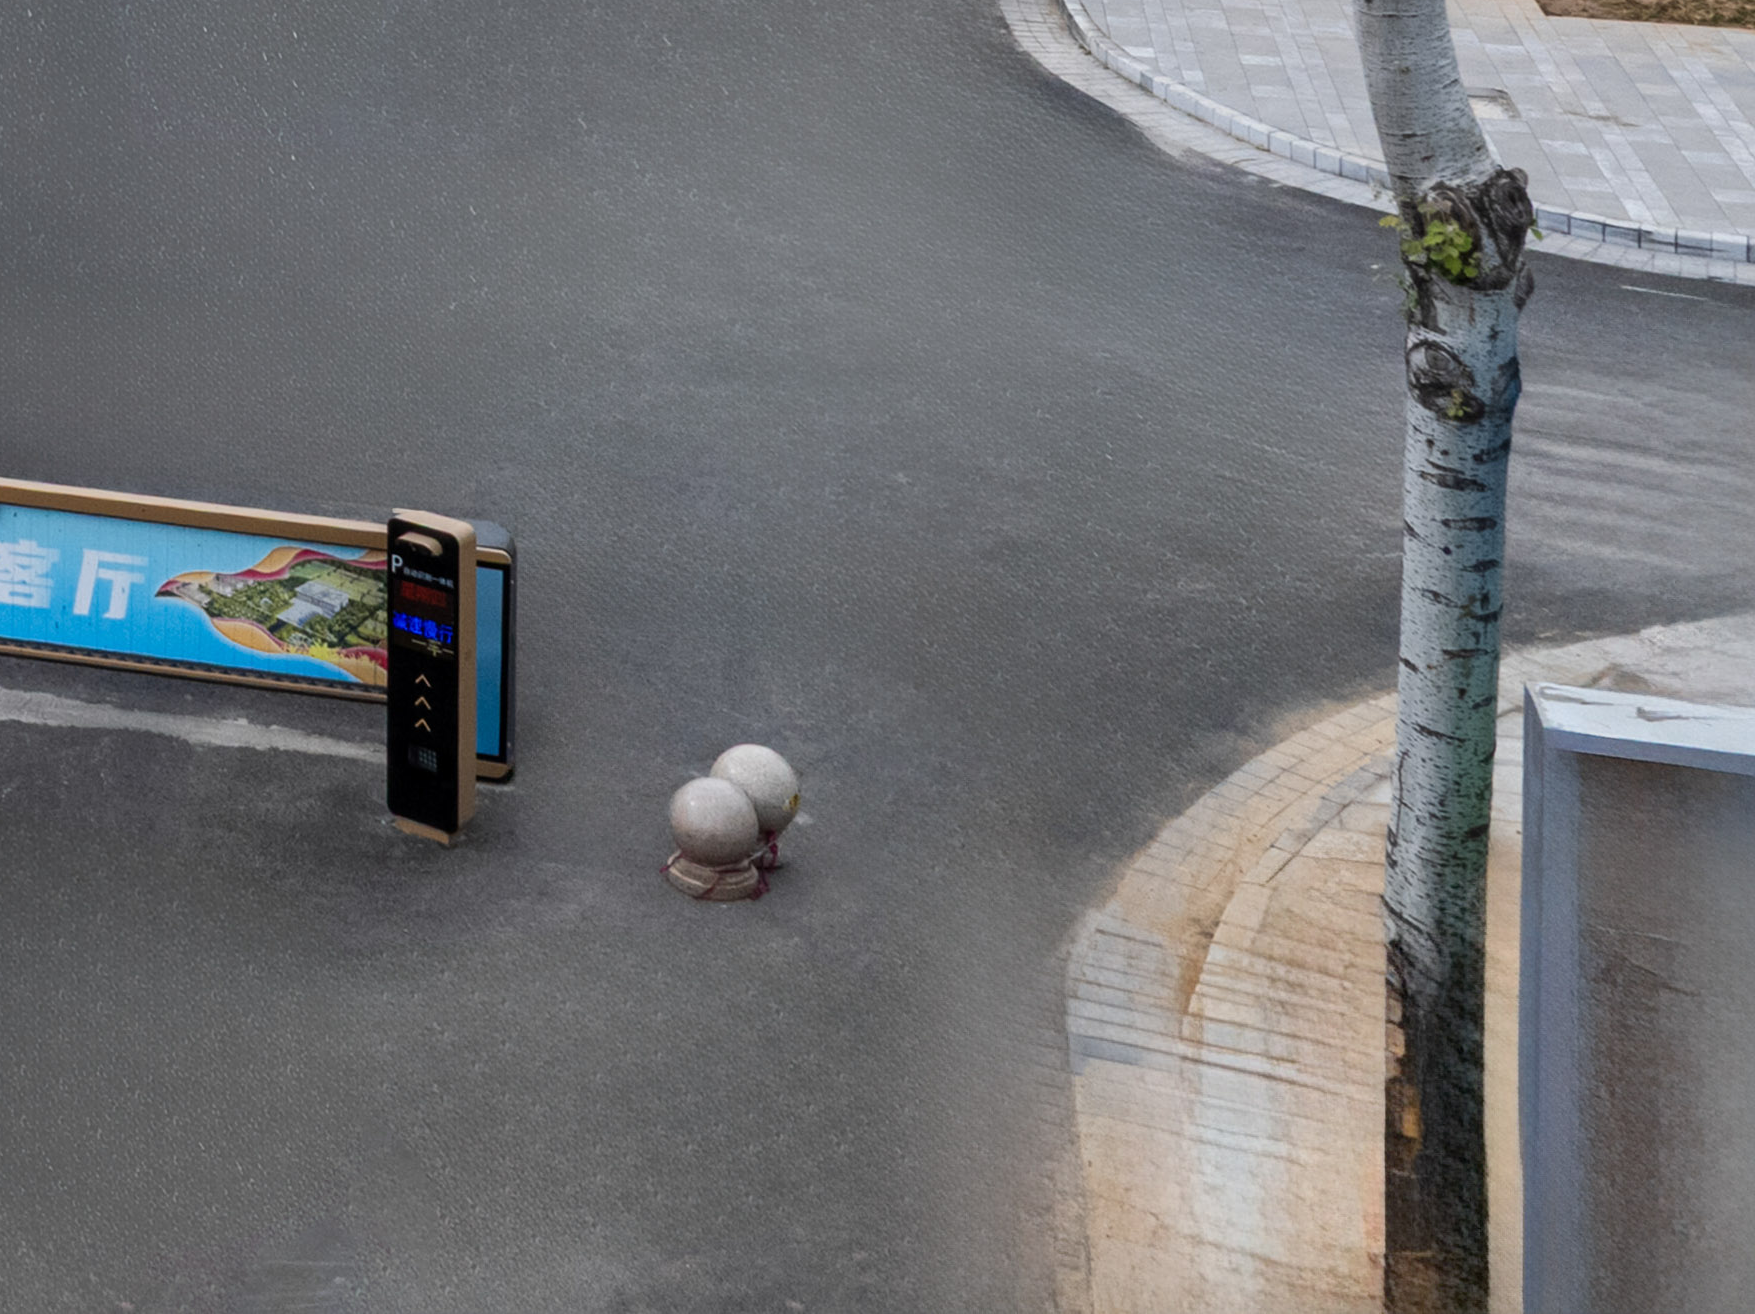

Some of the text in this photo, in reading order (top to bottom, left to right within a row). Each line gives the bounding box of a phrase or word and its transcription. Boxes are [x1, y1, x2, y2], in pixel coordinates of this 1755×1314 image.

[392, 554, 403, 574] P
[393, 611, 453, 644] 减速慢行
